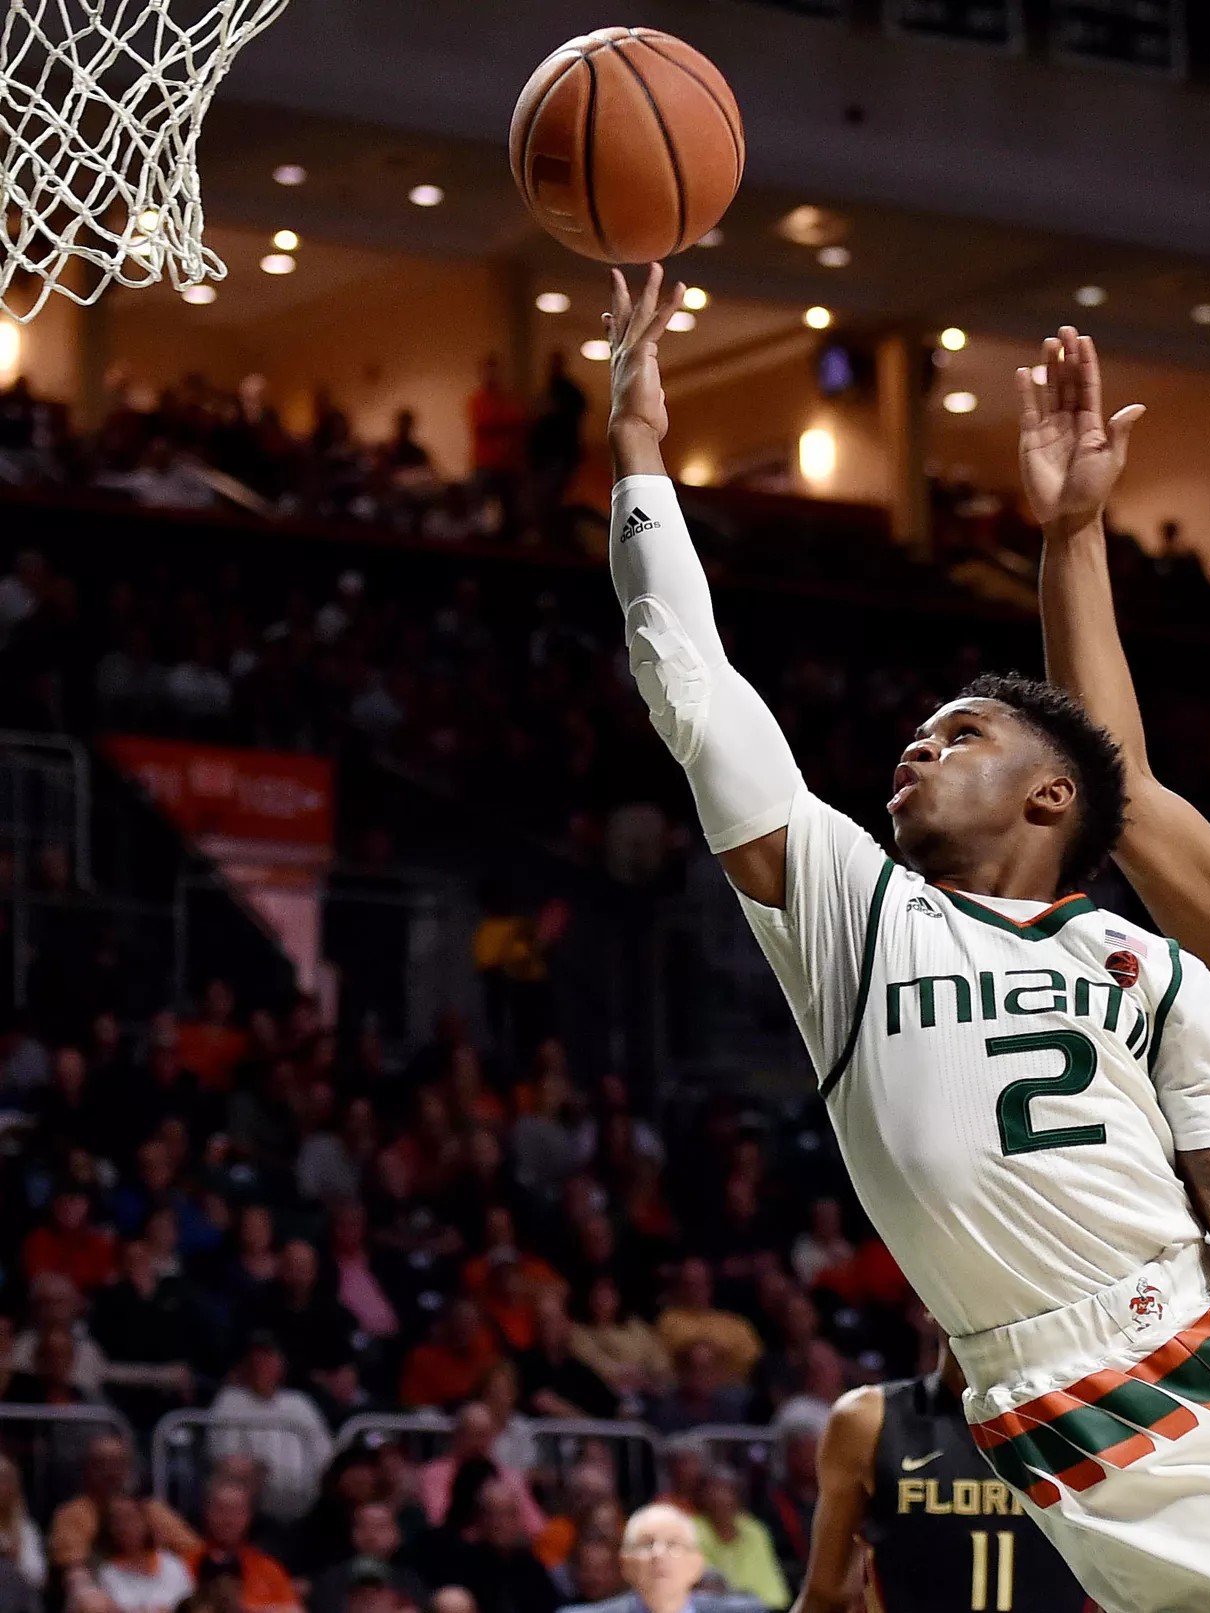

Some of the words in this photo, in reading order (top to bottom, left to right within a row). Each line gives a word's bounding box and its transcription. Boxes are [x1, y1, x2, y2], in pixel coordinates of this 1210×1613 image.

[619, 520, 662, 544] adidas
[985, 1029, 1107, 1157] 2
[970, 1530, 1014, 1612] 11
